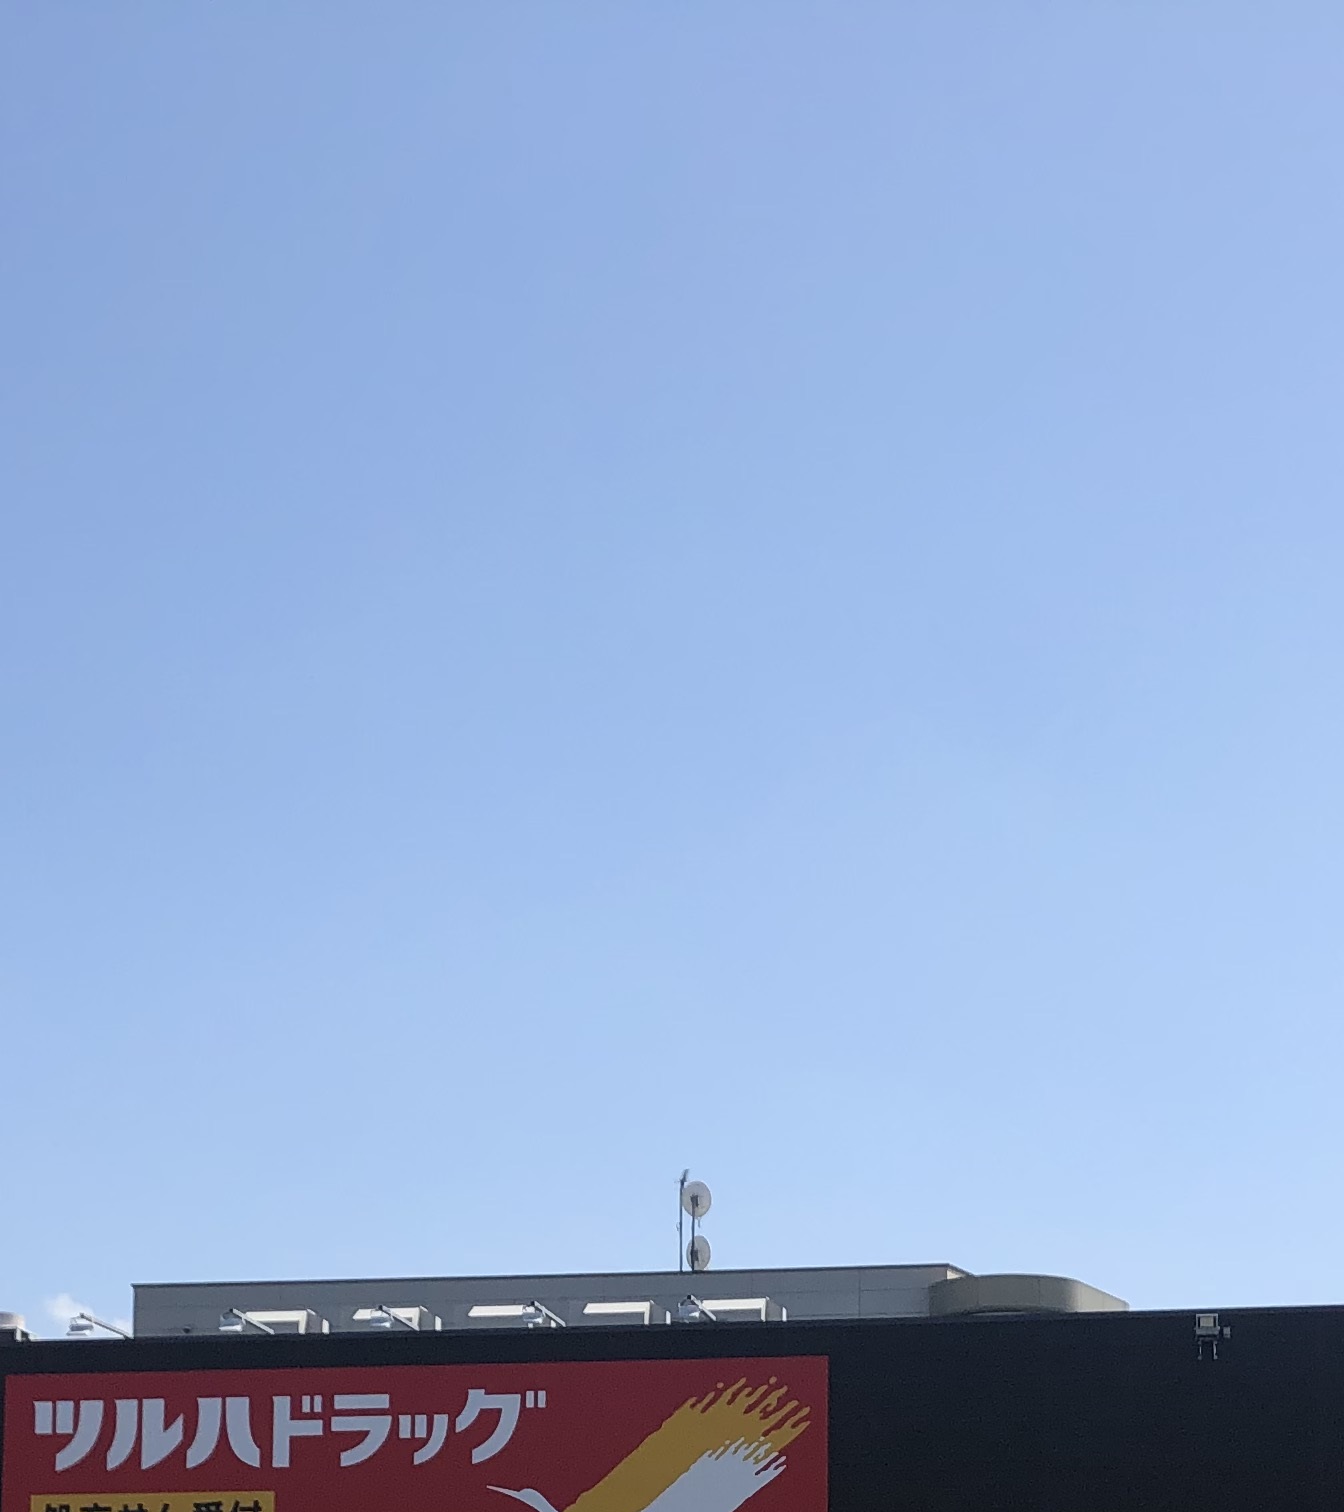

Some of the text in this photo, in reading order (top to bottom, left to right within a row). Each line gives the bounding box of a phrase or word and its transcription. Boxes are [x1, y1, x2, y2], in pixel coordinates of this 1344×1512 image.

[32, 1388, 548, 1472] ツルハドラッグ
